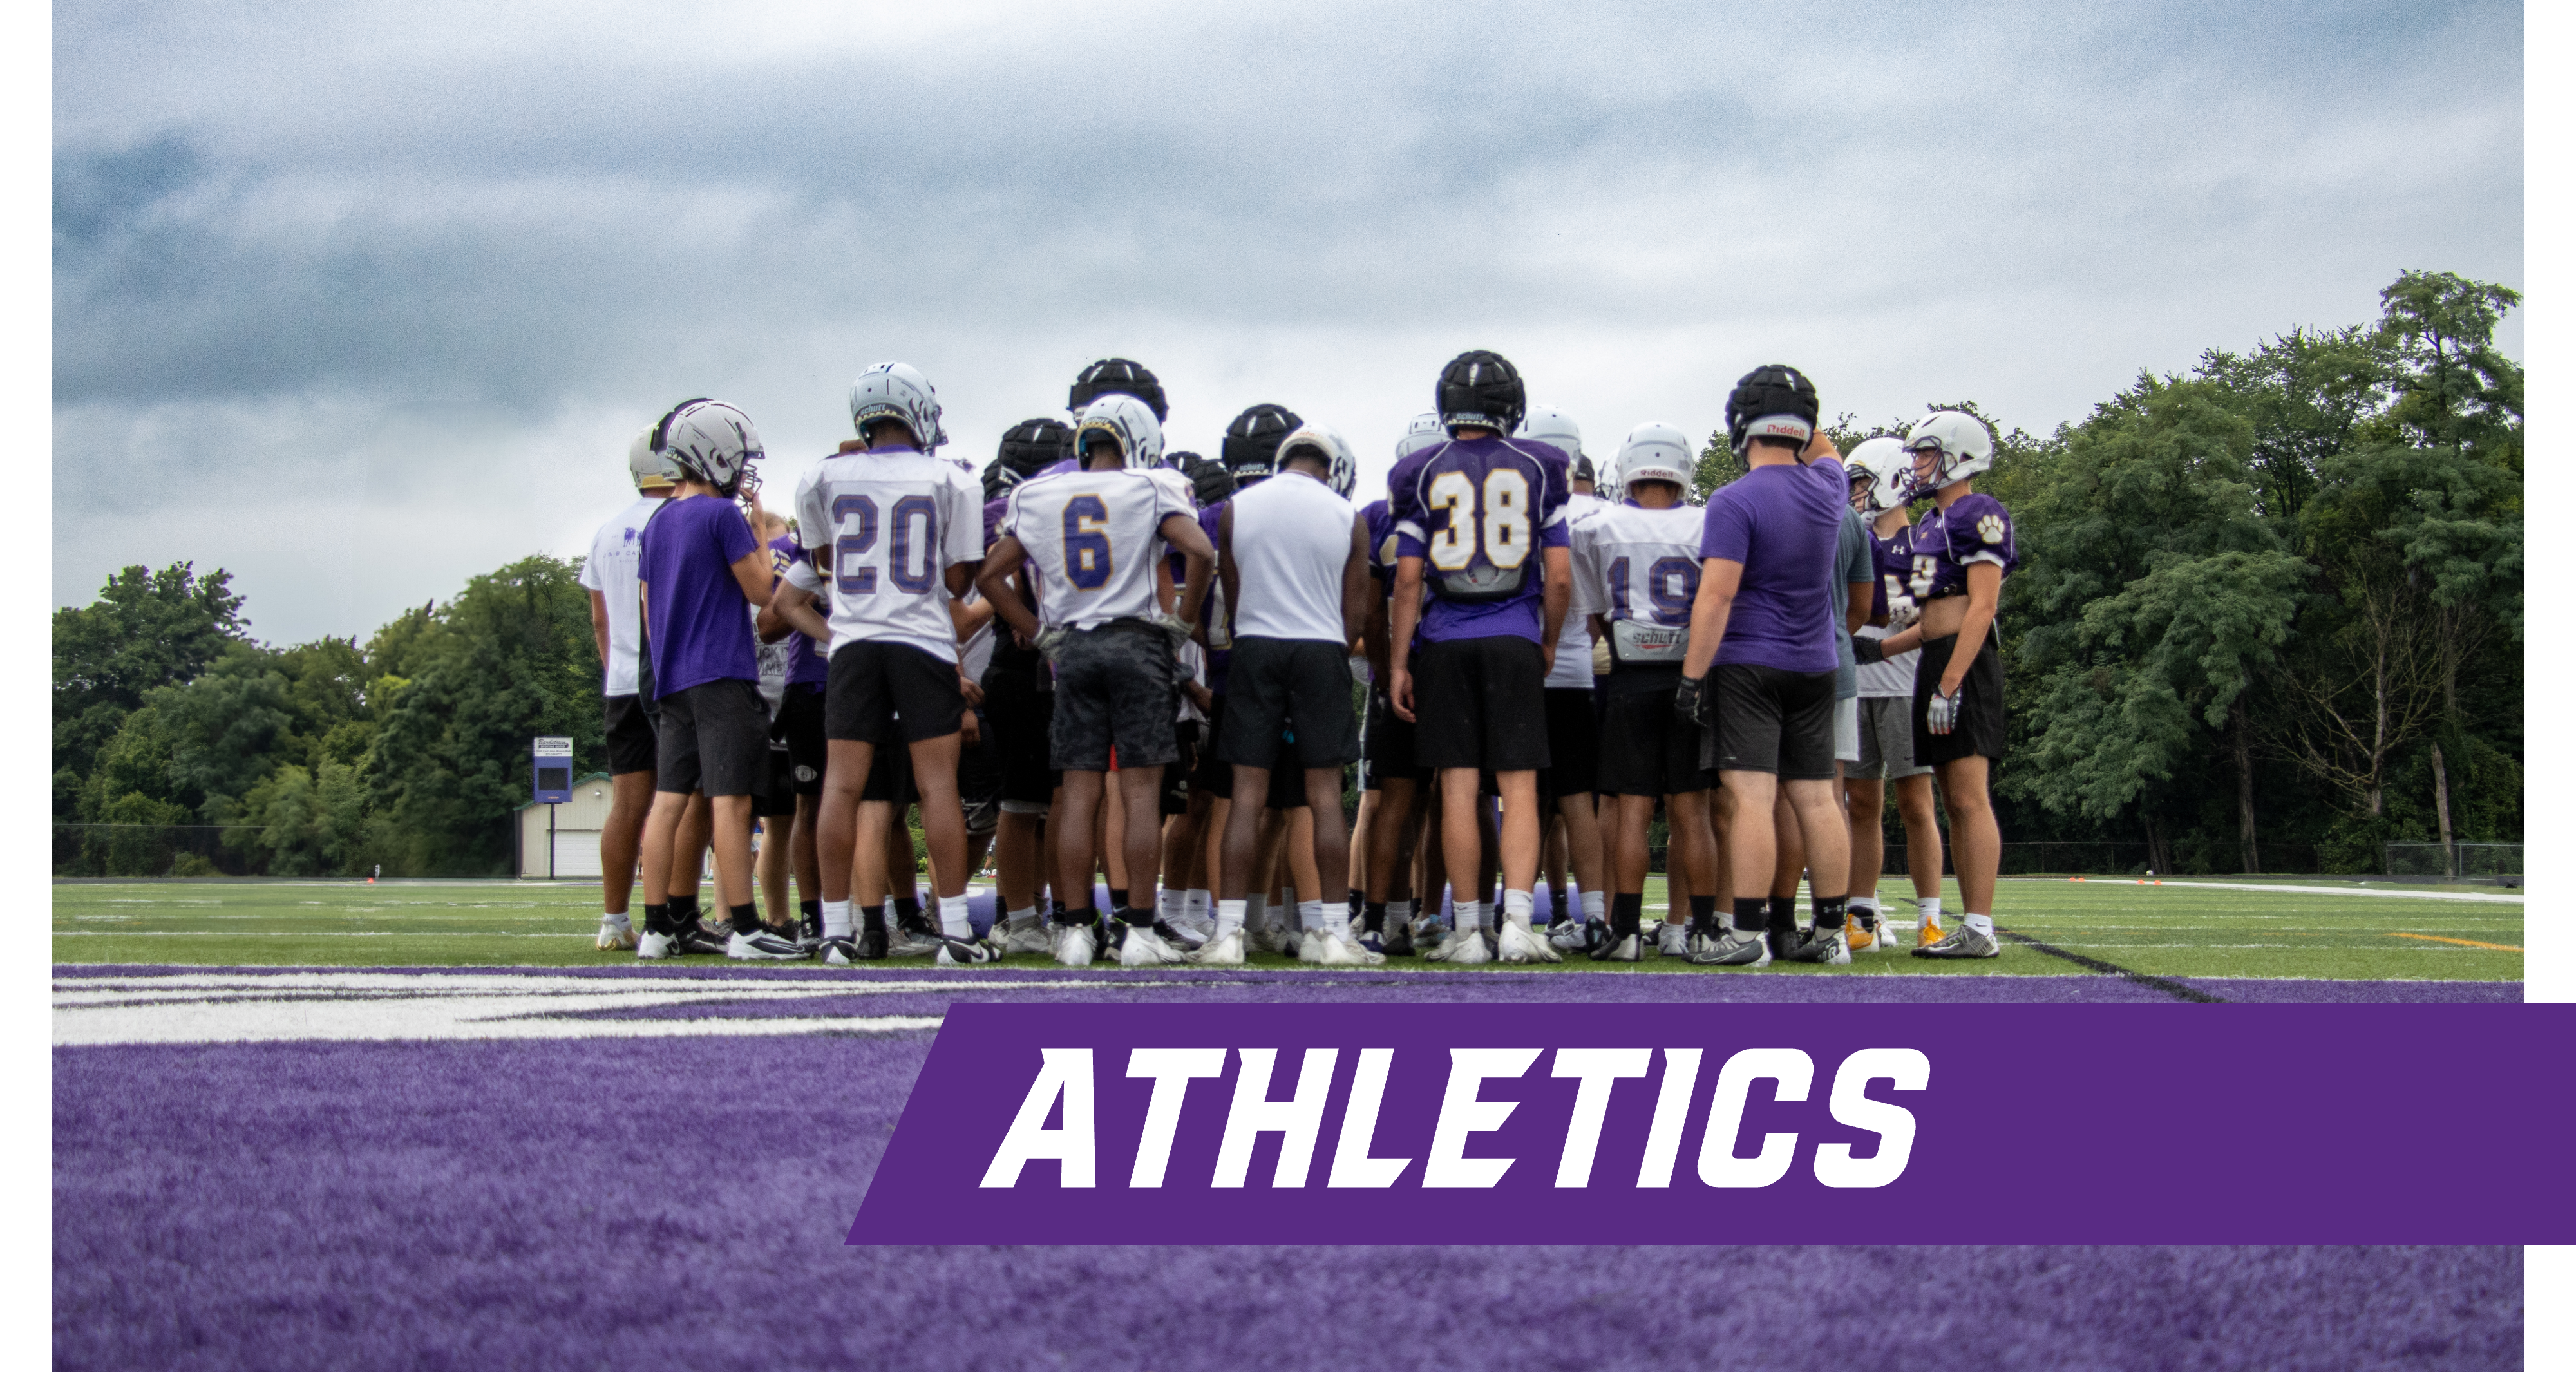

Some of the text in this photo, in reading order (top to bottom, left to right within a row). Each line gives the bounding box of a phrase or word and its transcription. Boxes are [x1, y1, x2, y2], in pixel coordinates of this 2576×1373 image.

[860, 403, 886, 415] schutt
[1766, 424, 1805, 438] Riddell
[1239, 463, 1265, 471] schutt
[1640, 469, 1674, 478] Riddell
[1429, 468, 1531, 571] 38
[831, 494, 938, 595] 20
[1062, 493, 1114, 592] 6
[1607, 556, 1700, 629] 19
